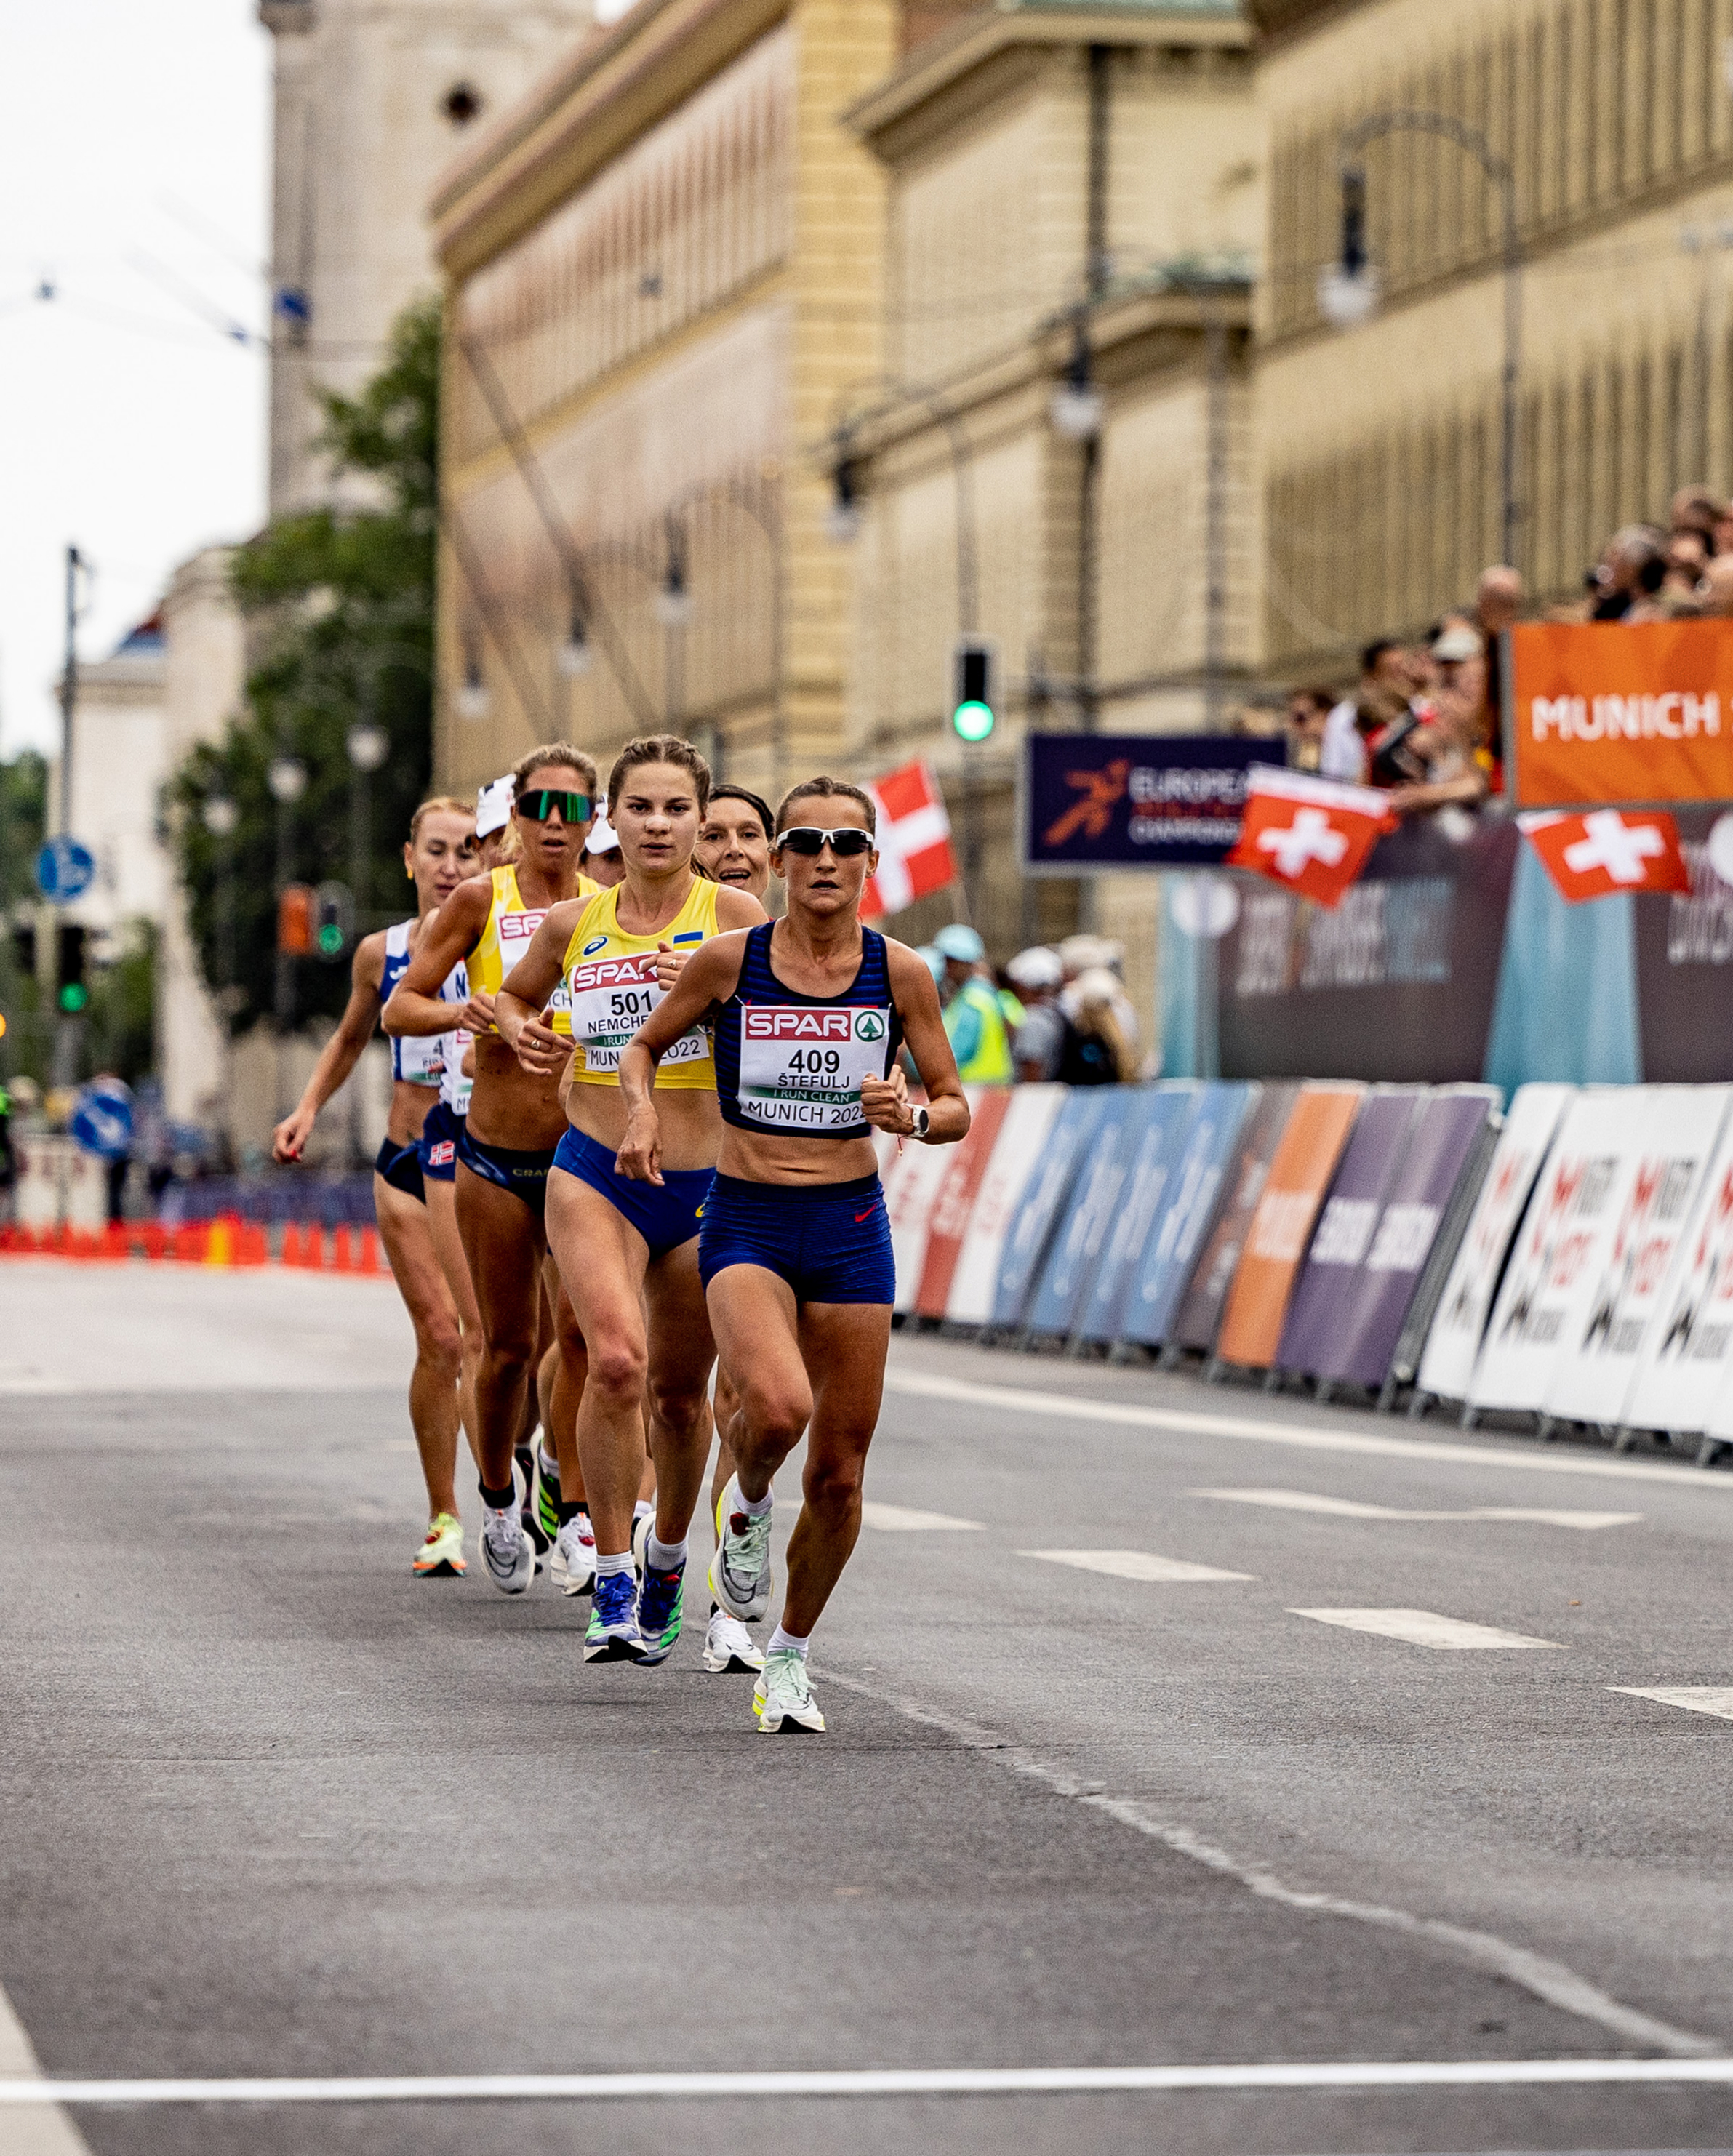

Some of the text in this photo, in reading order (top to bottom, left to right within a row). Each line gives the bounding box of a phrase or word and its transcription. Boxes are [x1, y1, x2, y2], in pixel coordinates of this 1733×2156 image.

[1531, 692, 1721, 741] MUNICH
[502, 915, 543, 938] SP
[611, 990, 652, 1015] 501
[588, 1015, 649, 1033] NEMCHE
[748, 1013, 849, 1037] SPAR
[591, 1051, 619, 1066] MUN
[788, 1049, 840, 1073] 409
[777, 1073, 850, 1089] ŠTEFULJ
[780, 1090, 807, 1100] RUN
[748, 1101, 823, 1123] MUNICH
